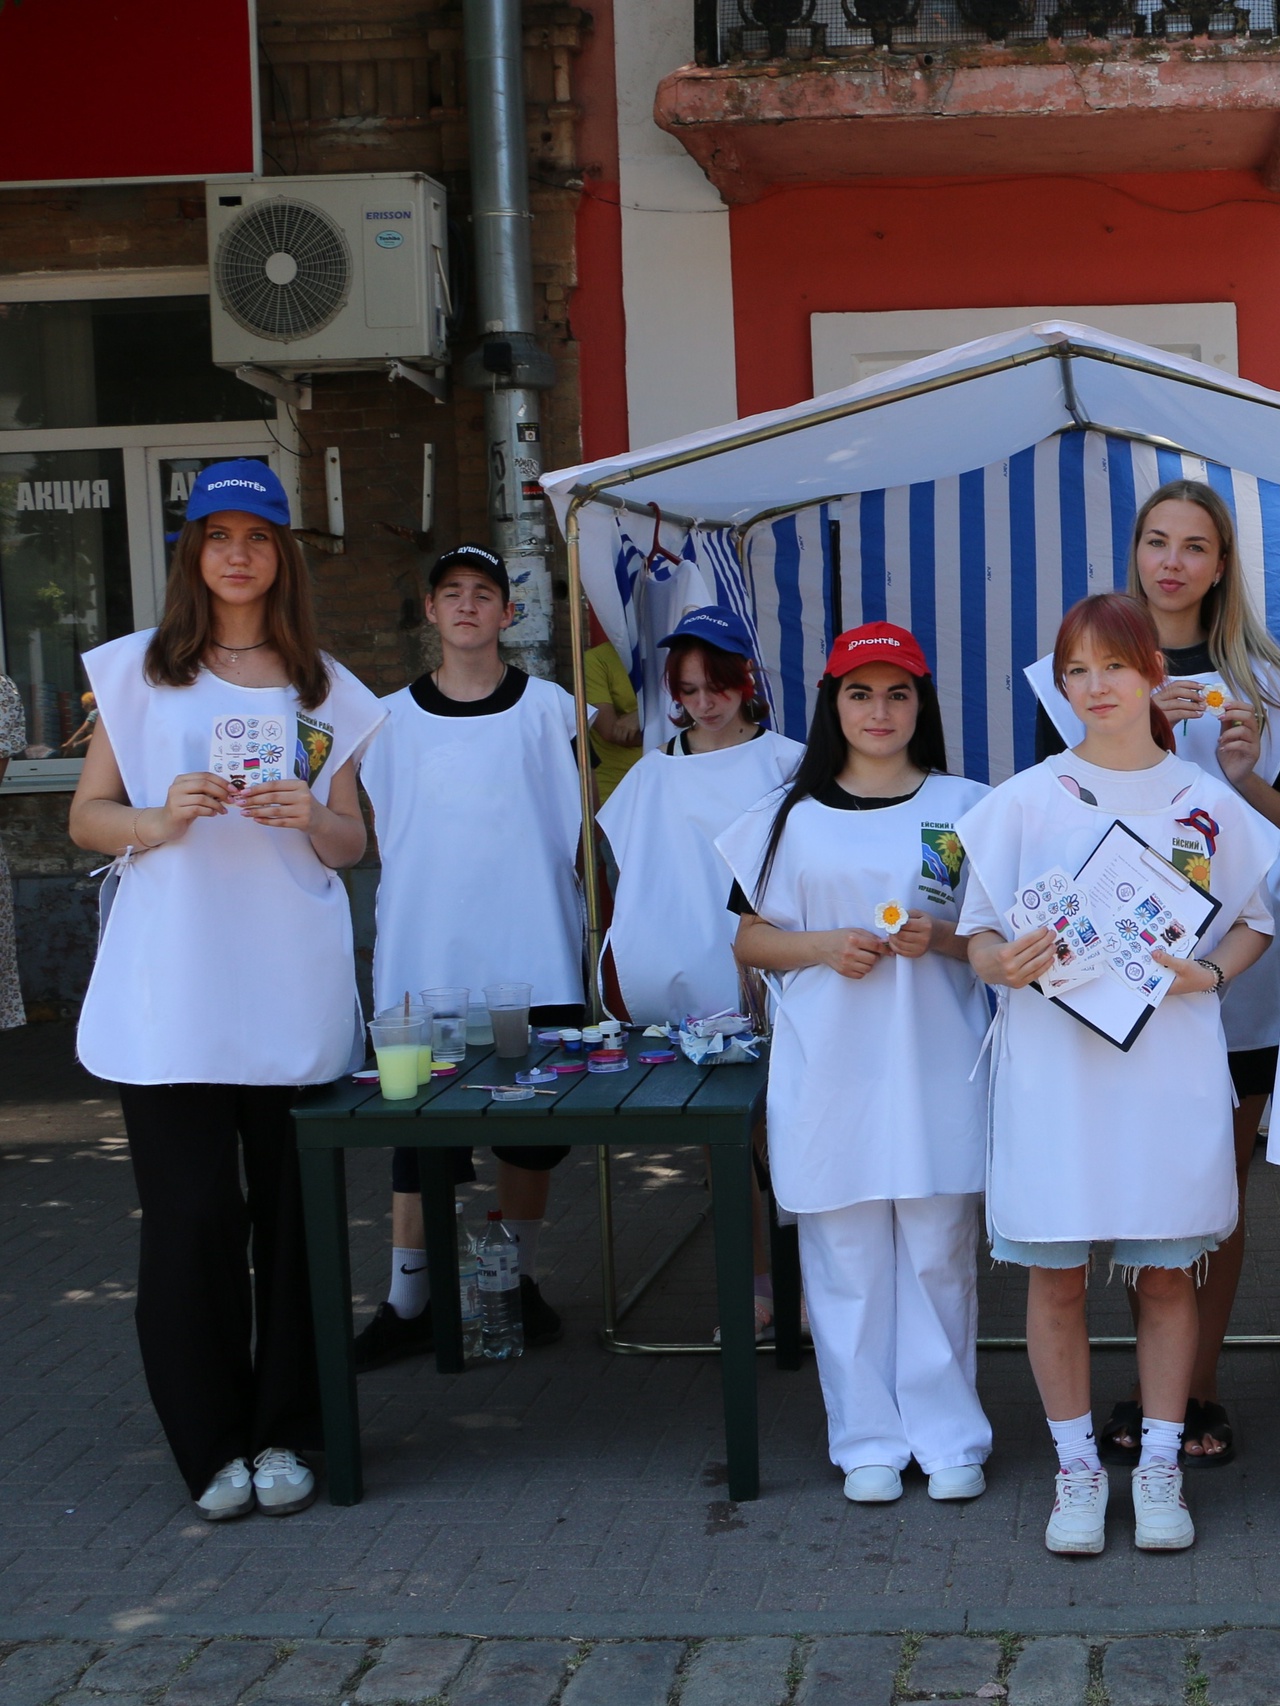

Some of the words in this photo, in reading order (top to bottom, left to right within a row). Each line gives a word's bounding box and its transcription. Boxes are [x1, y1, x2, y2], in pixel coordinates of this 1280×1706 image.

[366, 211, 412, 220] ERISSON
[208, 479, 267, 493] ВОЛОНТЁР
[17, 479, 110, 514] АКЦИЯ
[1172, 837, 1200, 850] ЕЙСКИЙ
